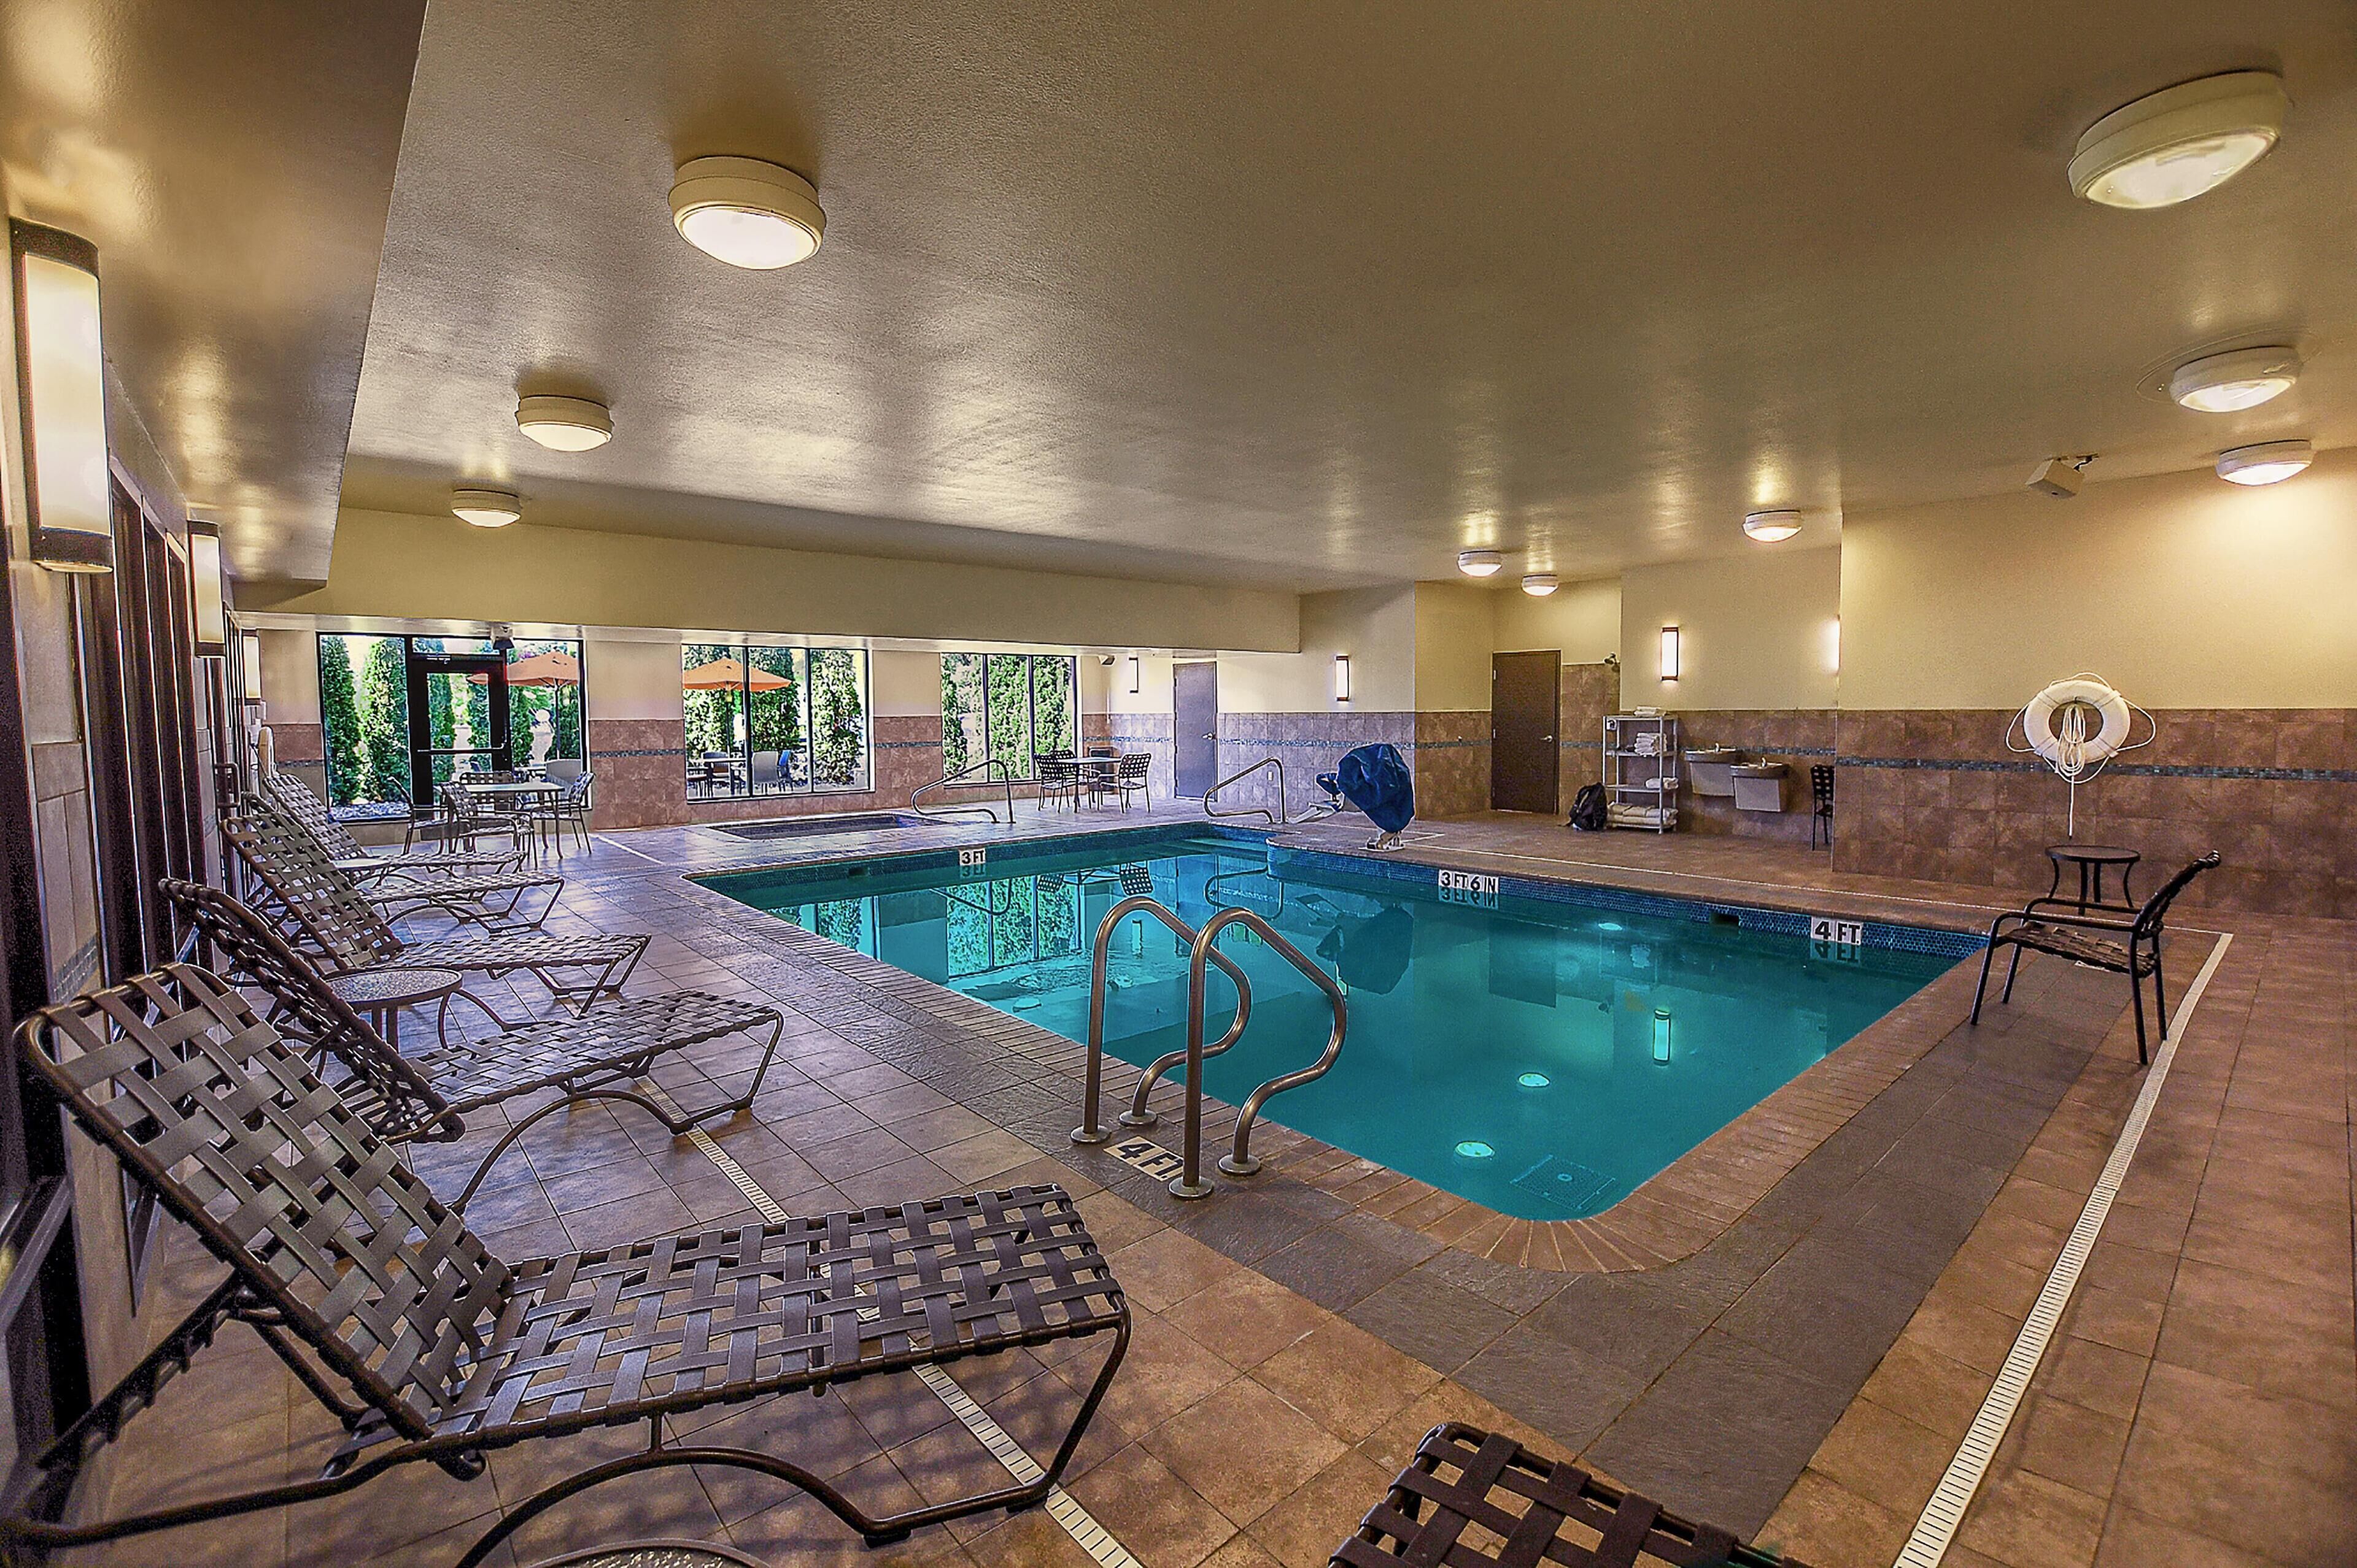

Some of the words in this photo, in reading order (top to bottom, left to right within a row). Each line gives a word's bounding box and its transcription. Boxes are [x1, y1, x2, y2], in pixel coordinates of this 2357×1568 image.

[962, 852, 970, 864] 3
[1441, 872, 1450, 886] 3
[1471, 876, 1480, 890] 6
[1484, 877, 1495, 892] IN
[1815, 921, 1831, 940] 4
[1838, 923, 1860, 944] FT.
[1117, 1143, 1155, 1159] 4
